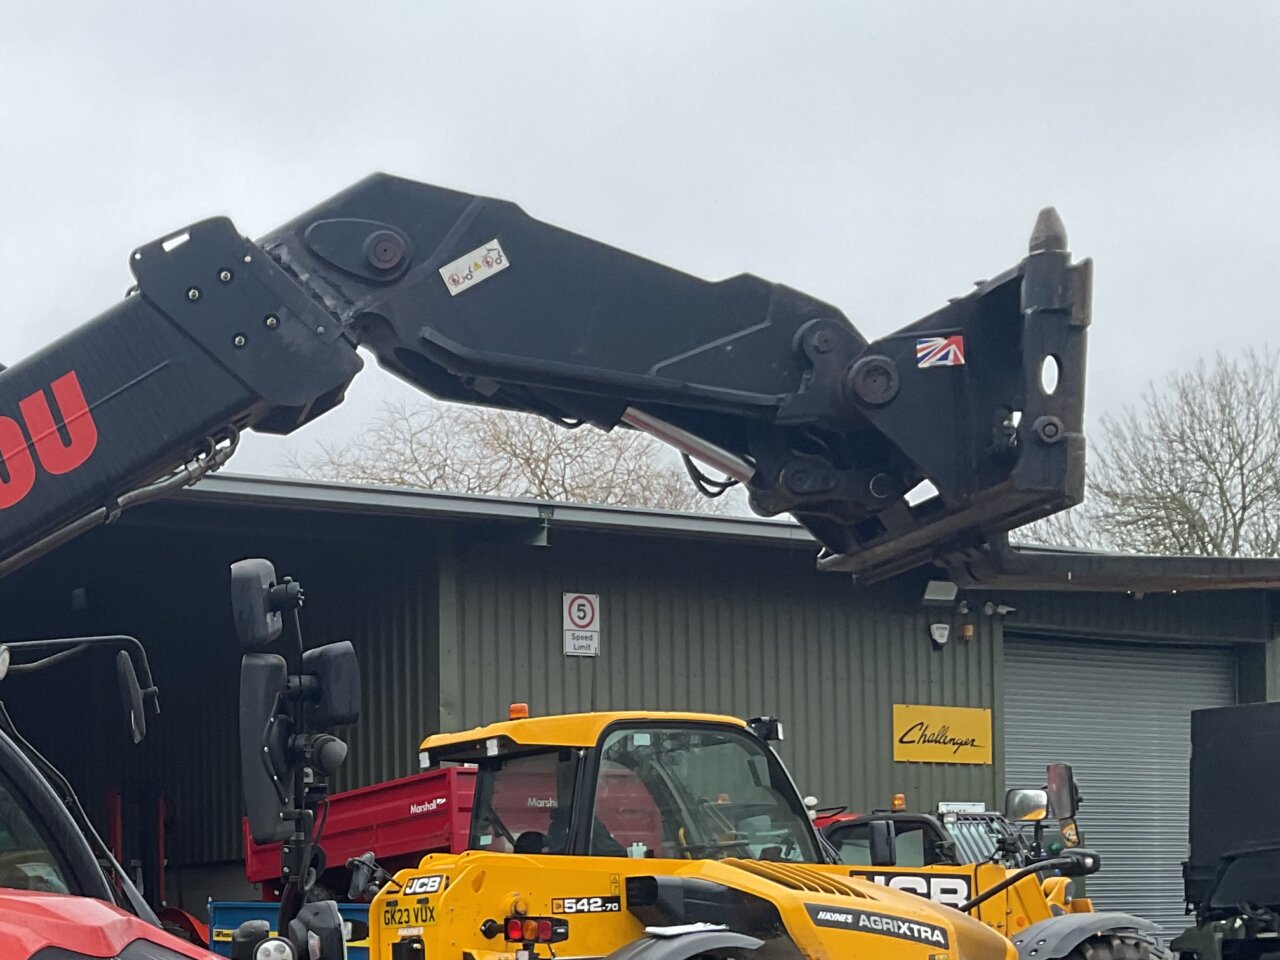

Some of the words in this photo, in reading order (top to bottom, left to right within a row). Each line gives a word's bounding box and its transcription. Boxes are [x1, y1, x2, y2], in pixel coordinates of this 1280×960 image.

[577, 603, 587, 620] 5
[571, 633, 593, 641] Speed
[573, 643, 592, 651] Limit
[898, 722, 984, 754] Challenger
[410, 800, 437, 814] Marshall
[404, 876, 441, 894] JCB
[564, 898, 619, 912] 542-70
[383, 908, 410, 925] GK23
[413, 906, 436, 923] VUX
[817, 911, 853, 923] HAYNES
[858, 914, 945, 943] AGRIXTRA
